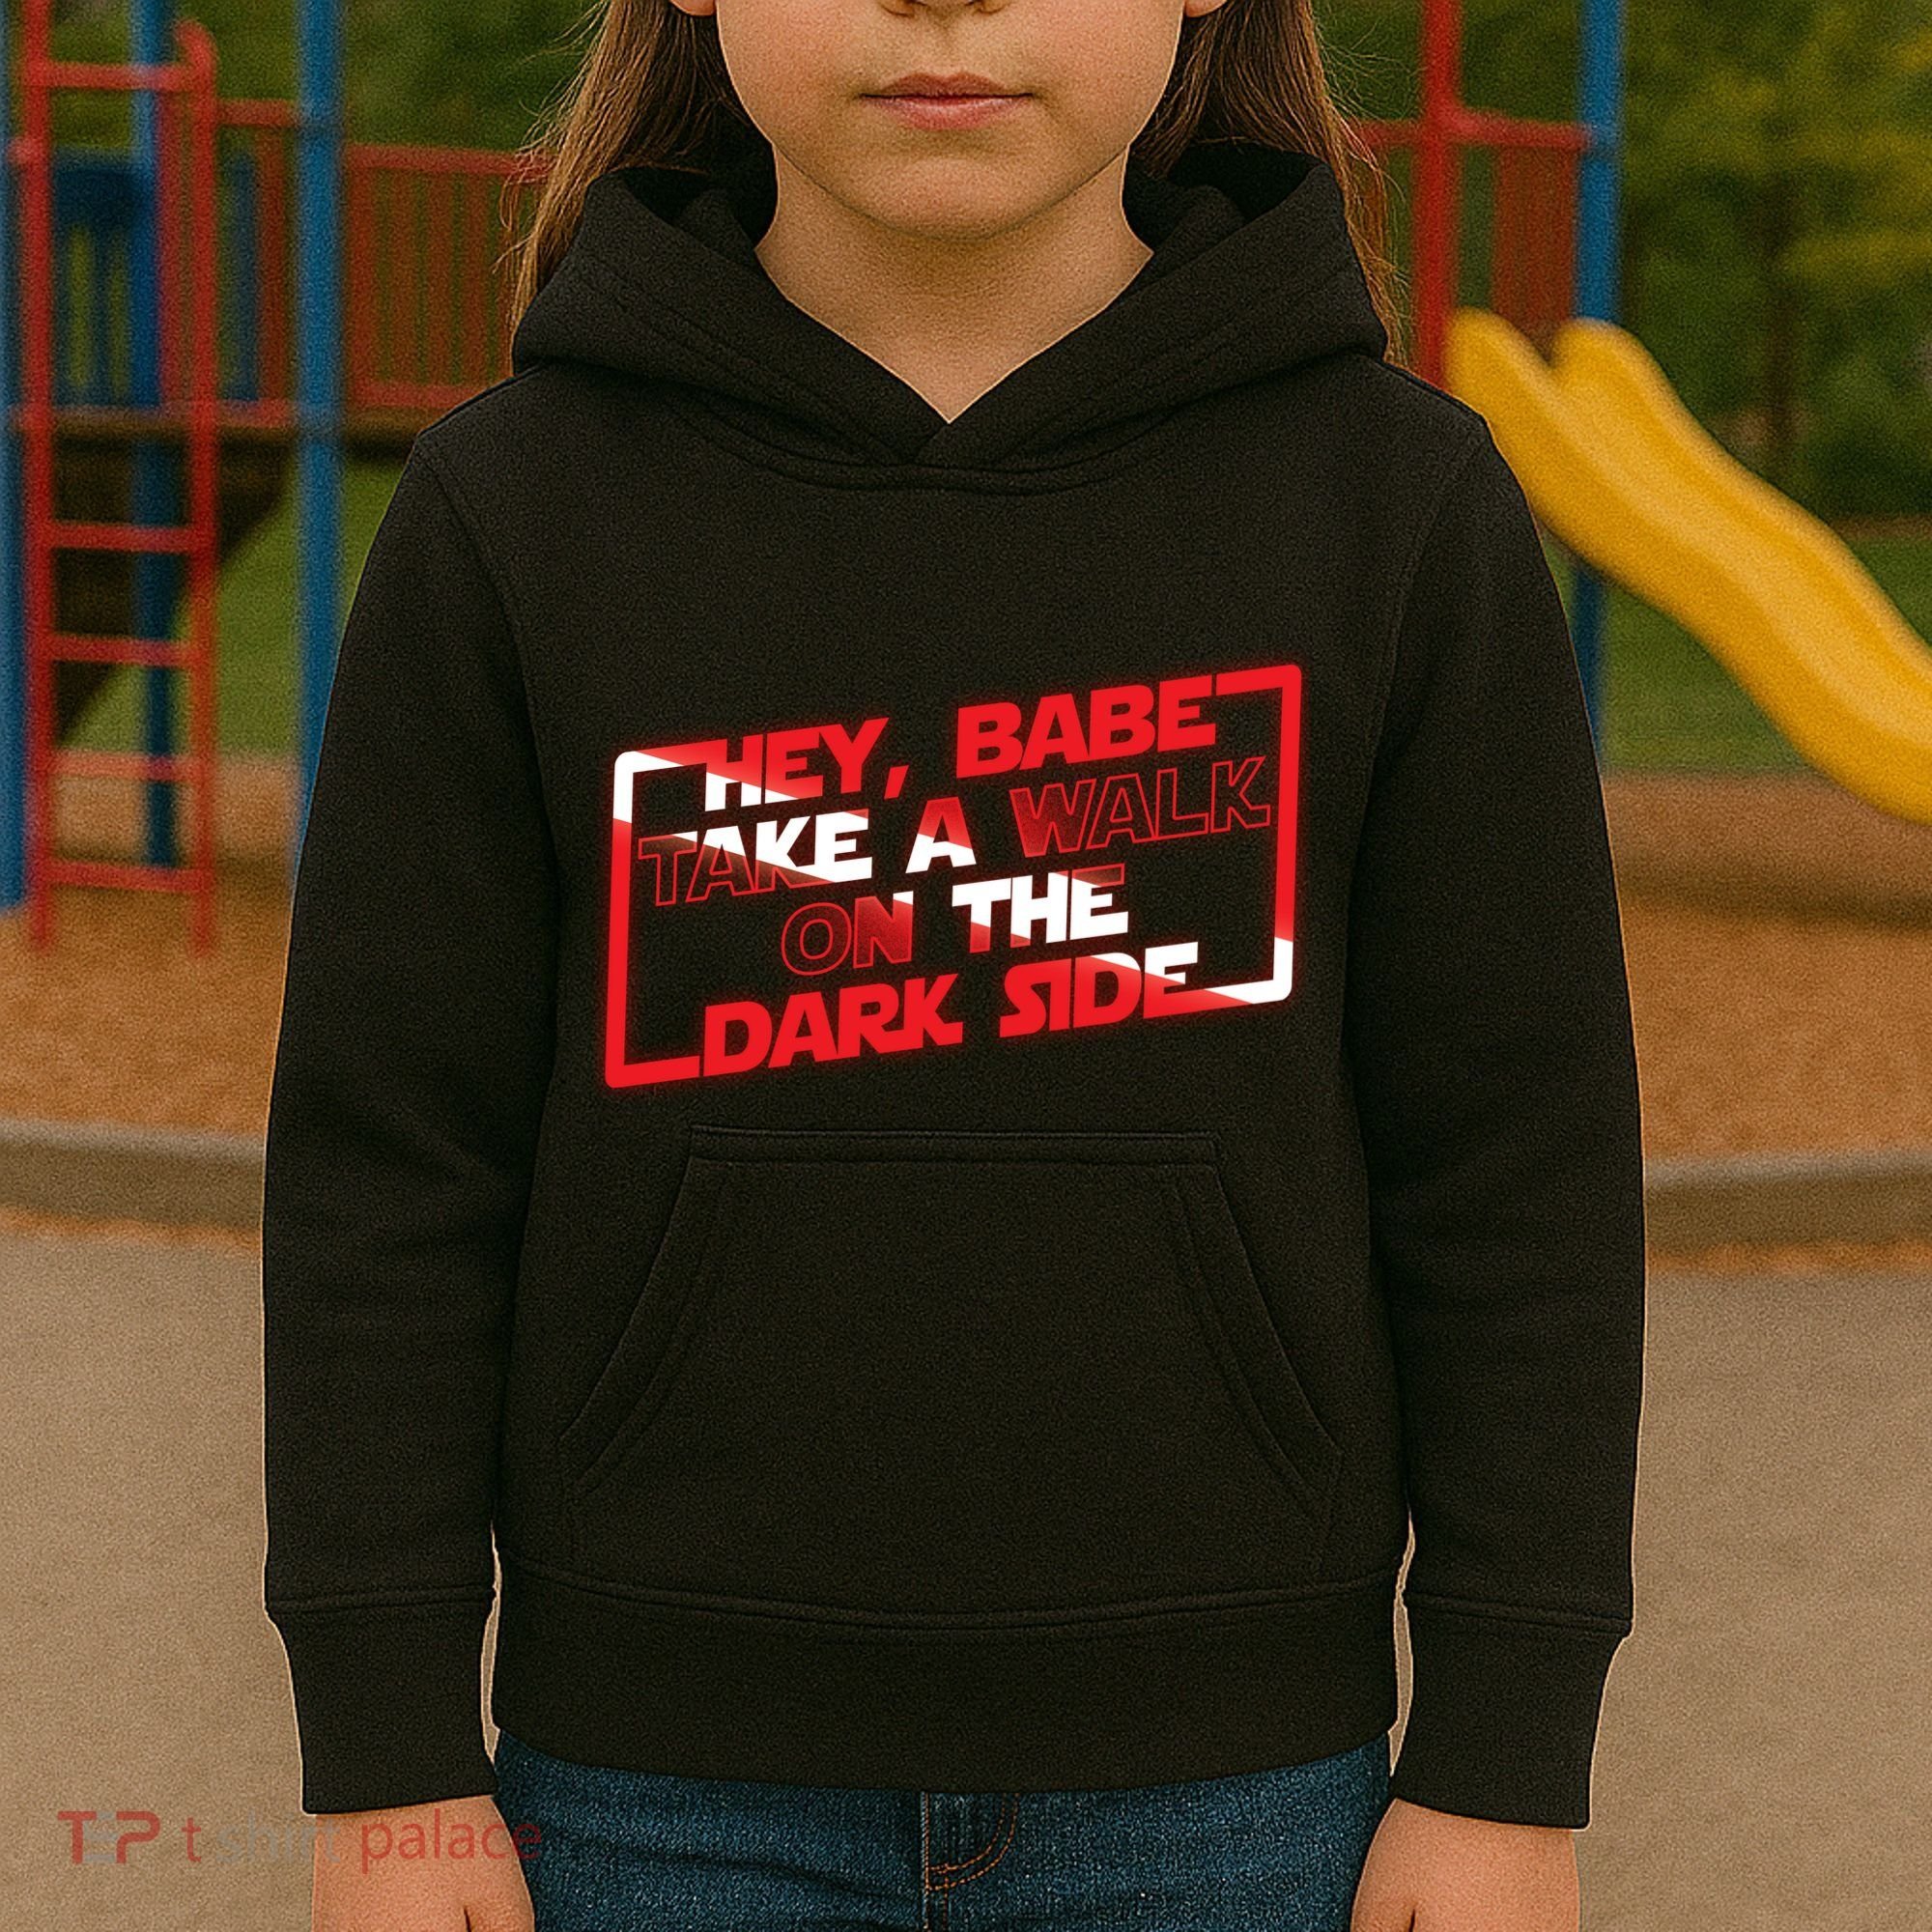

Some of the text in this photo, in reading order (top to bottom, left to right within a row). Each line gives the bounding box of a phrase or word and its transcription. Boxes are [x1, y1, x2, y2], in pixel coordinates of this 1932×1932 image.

[955, 674, 1217, 779] BABE
[638, 755, 1271, 907] TAKE A WALK
[781, 864, 1129, 976] ON THE
[702, 941, 1200, 1077] DARK SIDE
